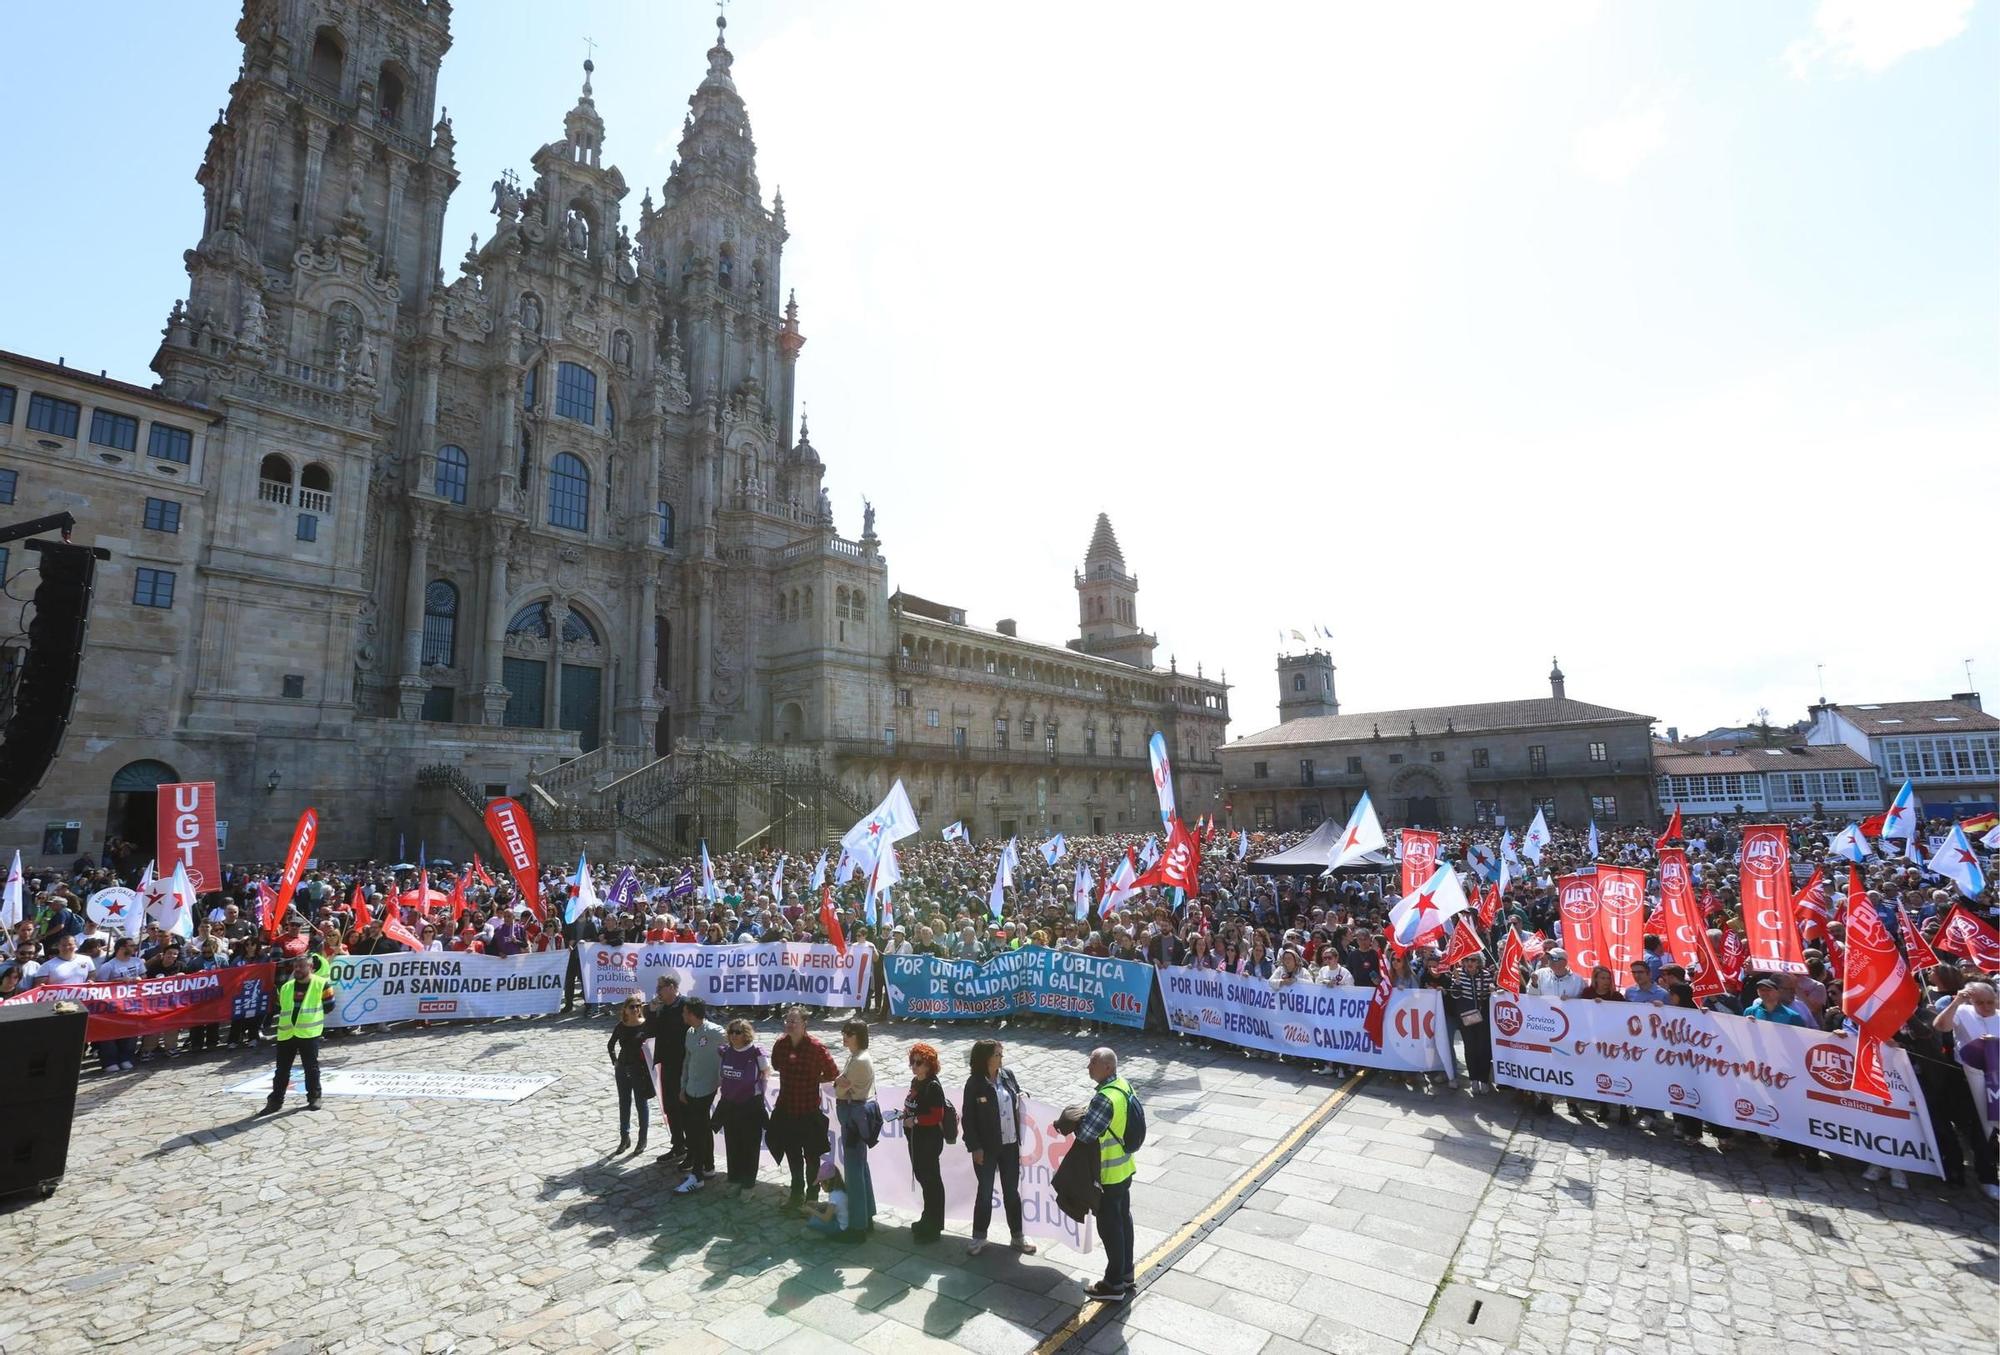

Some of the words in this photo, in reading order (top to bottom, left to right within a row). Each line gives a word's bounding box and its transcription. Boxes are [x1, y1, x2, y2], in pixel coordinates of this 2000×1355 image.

[175, 786, 201, 867] UGT
[497, 809, 531, 871] CCOO
[1408, 842, 1431, 855] UGT
[1748, 840, 1778, 858] UGT
[1564, 887, 1593, 904] UGT
[1601, 880, 1637, 900] UGT
[1753, 879, 1785, 960] UGT
[597, 951, 639, 968] SOS
[644, 952, 714, 968] SANIDADE
[717, 950, 778, 968] PÚBLICA
[781, 952, 800, 967] EN
[803, 954, 855, 969] PERIGO
[1571, 922, 1601, 986] UG
[360, 963, 383, 979] EN
[388, 961, 462, 978] DEFENSA
[597, 972, 638, 983] pública
[894, 957, 923, 976] POR
[930, 961, 974, 980] UNHA
[1051, 952, 1124, 982] PÚBLICA
[36, 985, 113, 1004] PRIMARIA
[116, 983, 137, 999] DE
[141, 975, 220, 997] SEGUNDA
[383, 980, 405, 996] DA
[410, 977, 491, 994] SANIDADE
[496, 974, 562, 992] PÚBLICA
[709, 970, 852, 995] DEFENDÁMOLA
[930, 979, 948, 995] DE
[1049, 972, 1105, 998] GALIZA
[420, 1002, 455, 1012] CCOO
[908, 997, 950, 1013] SOMOS
[1039, 993, 1095, 1013] DEREITOS
[1110, 991, 1143, 1014] CIG
[1170, 976, 1193, 996] POR
[1195, 981, 1224, 1001] UNHA
[1226, 986, 1277, 1011] SANIDADE
[1279, 988, 1336, 1017] PÚBLICA
[1200, 1008, 1223, 1027] Máis
[1224, 1012, 1274, 1040] PERSOAL
[1283, 1024, 1311, 1044] Máis
[1526, 1014, 1555, 1025] Servizos
[1526, 1022, 1556, 1033] Públicos
[1595, 1040, 1648, 1062] noso
[1655, 1047, 1796, 1090] compromiso
[1811, 1048, 1853, 1075] UGT
[1496, 1060, 1575, 1087] ESENCIAIS
[1840, 1097, 1874, 1113] Galicia
